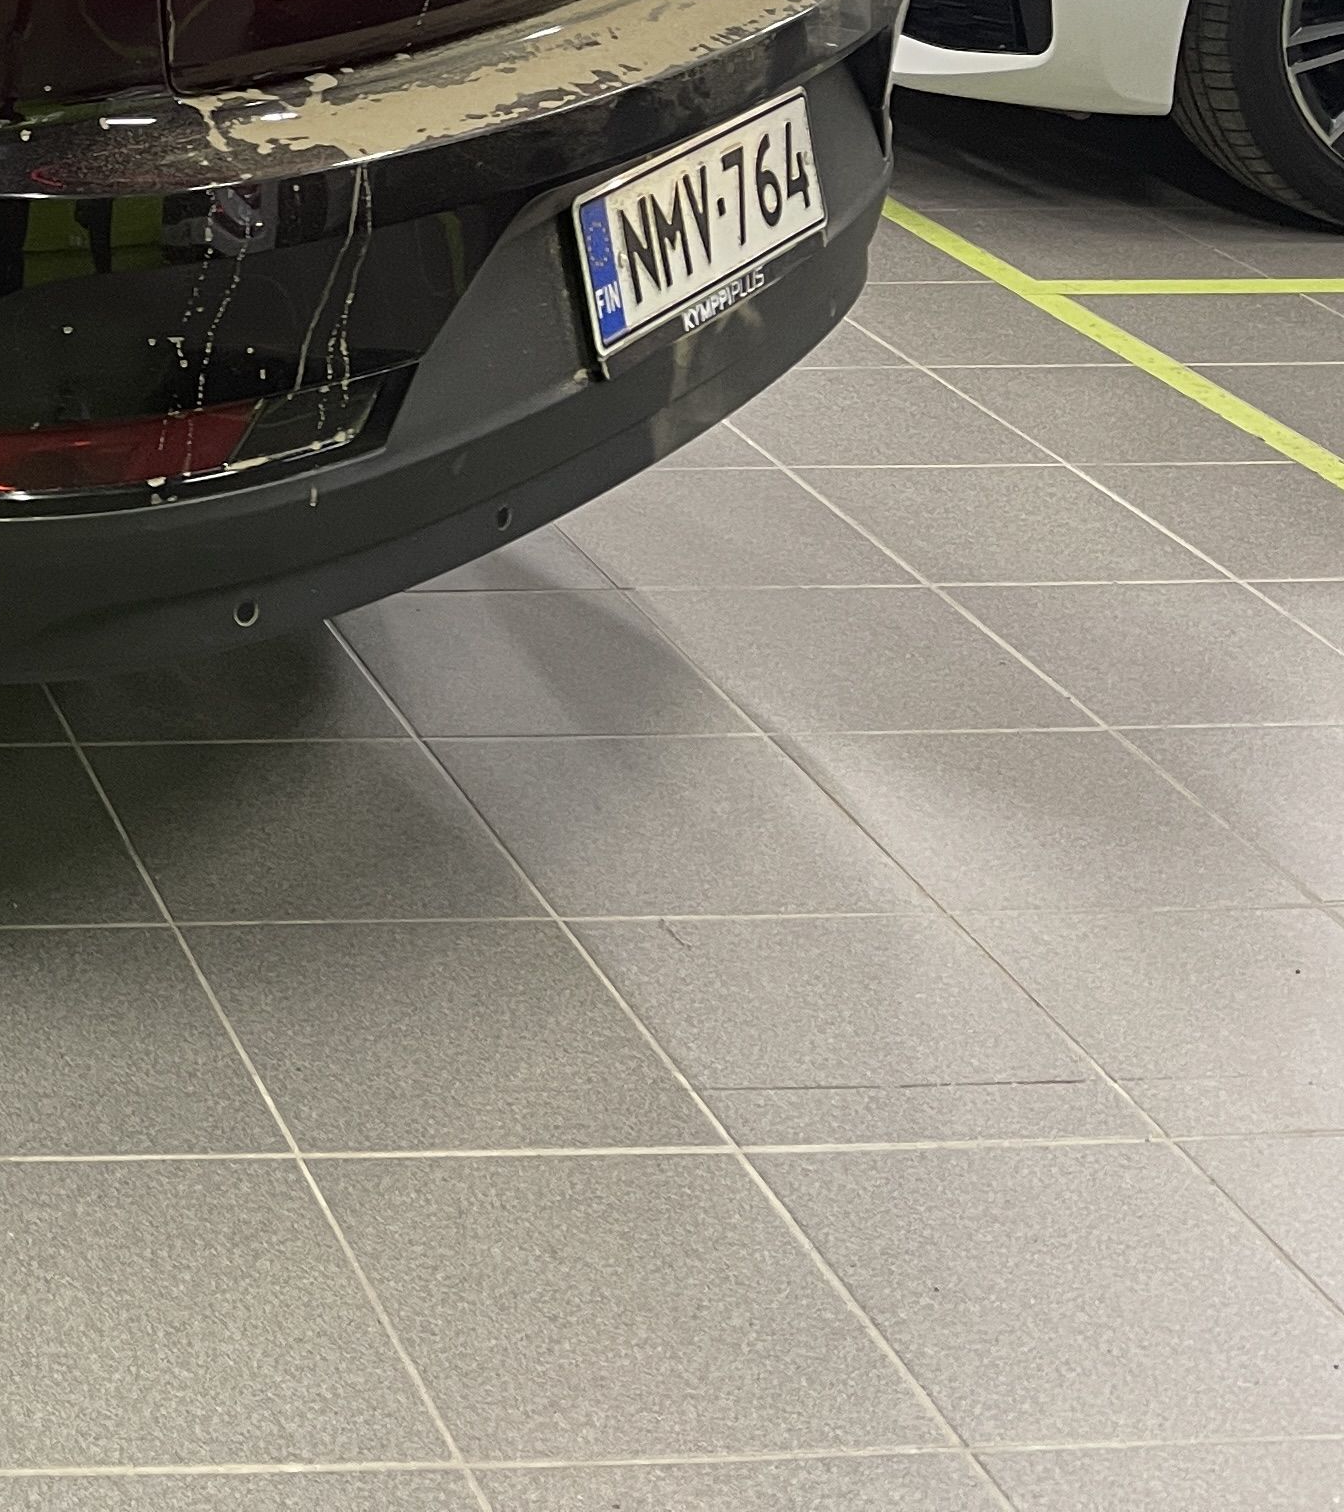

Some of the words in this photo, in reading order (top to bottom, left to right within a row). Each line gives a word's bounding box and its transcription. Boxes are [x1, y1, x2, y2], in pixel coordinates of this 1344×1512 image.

[618, 121, 812, 306] NMV-764
[594, 281, 623, 320] FIN
[681, 267, 766, 332] KYMPPIPLUS
